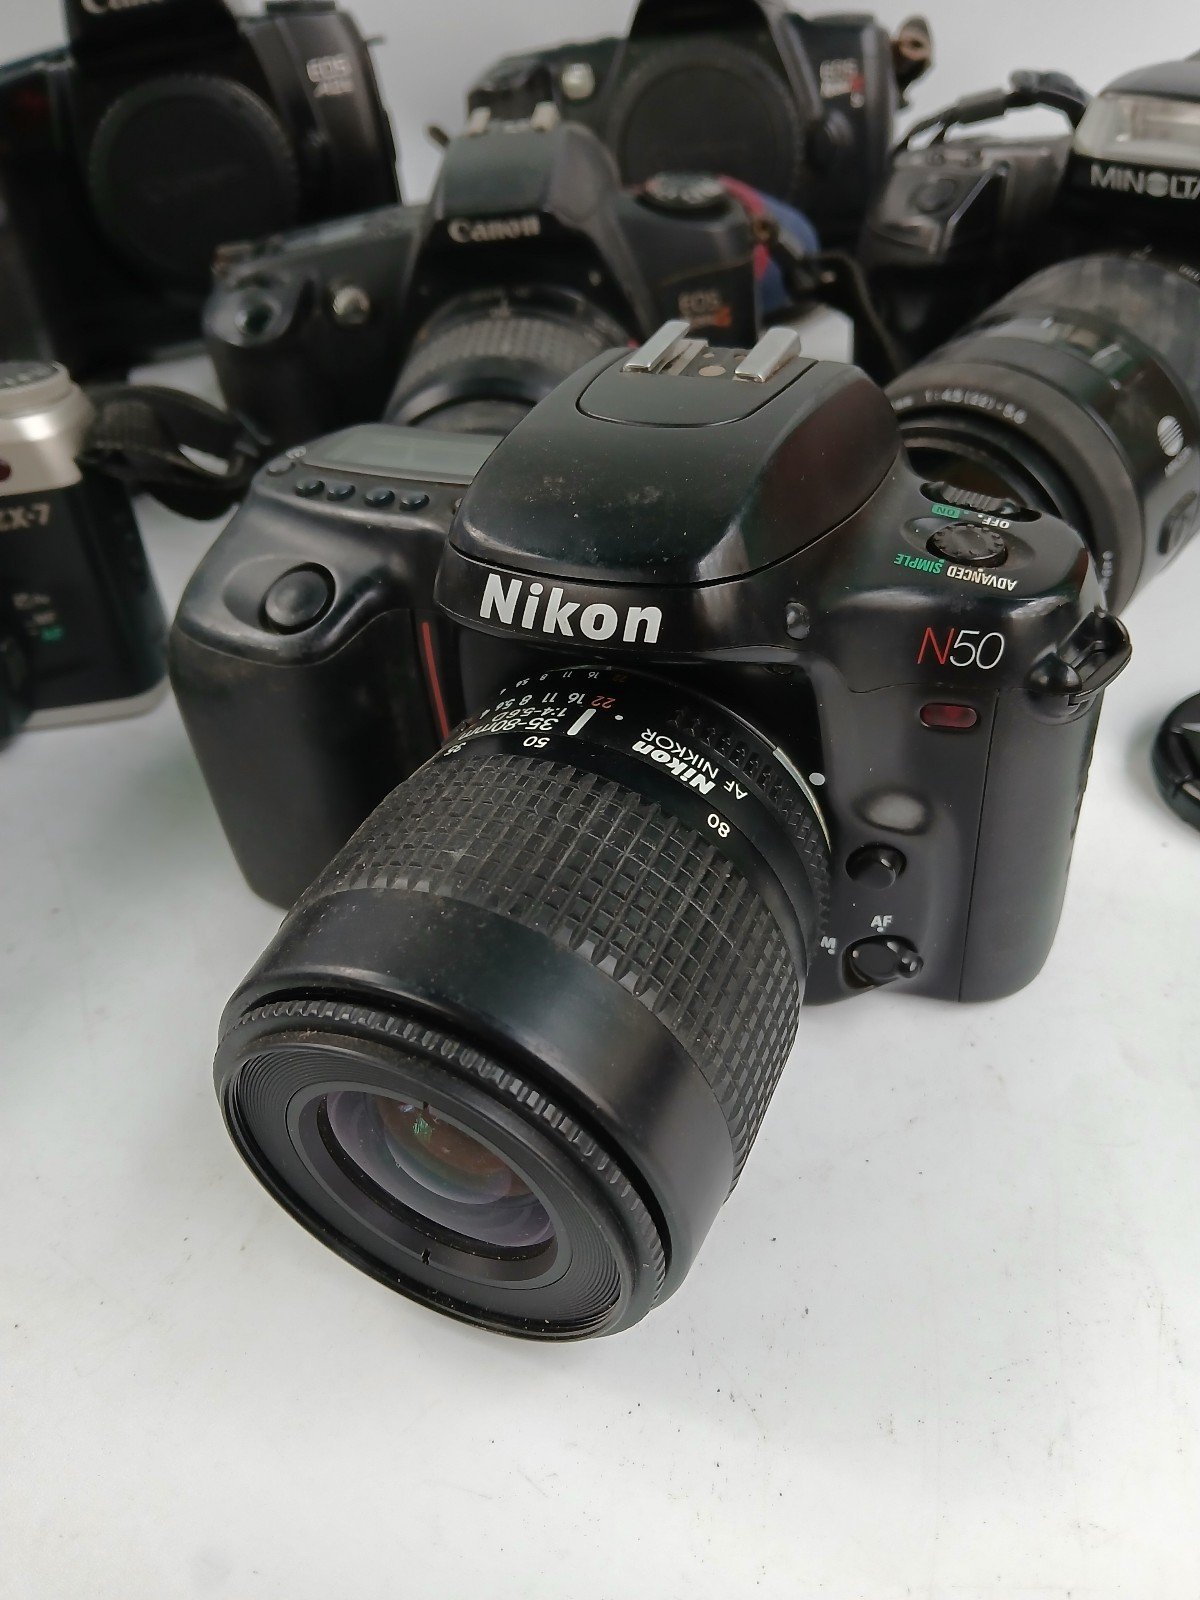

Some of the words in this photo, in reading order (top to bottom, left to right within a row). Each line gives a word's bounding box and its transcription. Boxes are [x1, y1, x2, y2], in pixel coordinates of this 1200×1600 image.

[447, 217, 541, 243] Canon
[936, 506, 956, 518] ON
[981, 515, 1010, 529] OFF
[894, 553, 944, 575] SIMPLE
[946, 565, 1017, 592] ADVANCED
[479, 573, 662, 643] Nikon
[917, 626, 1005, 670] N50
[588, 671, 599, 679] 16
[518, 694, 533, 706] 8
[541, 692, 558, 703] 11
[568, 692, 586, 705] 16
[591, 695, 616, 709] 22
[457, 716, 559, 741] 35-80mm
[522, 736, 550, 749] 50
[640, 728, 719, 779] NIKKOR
[631, 740, 716, 795] Nikon
[723, 780, 749, 800] AF
[707, 813, 731, 838] 80
[870, 914, 893, 928] AF
[820, 936, 837, 949] M
